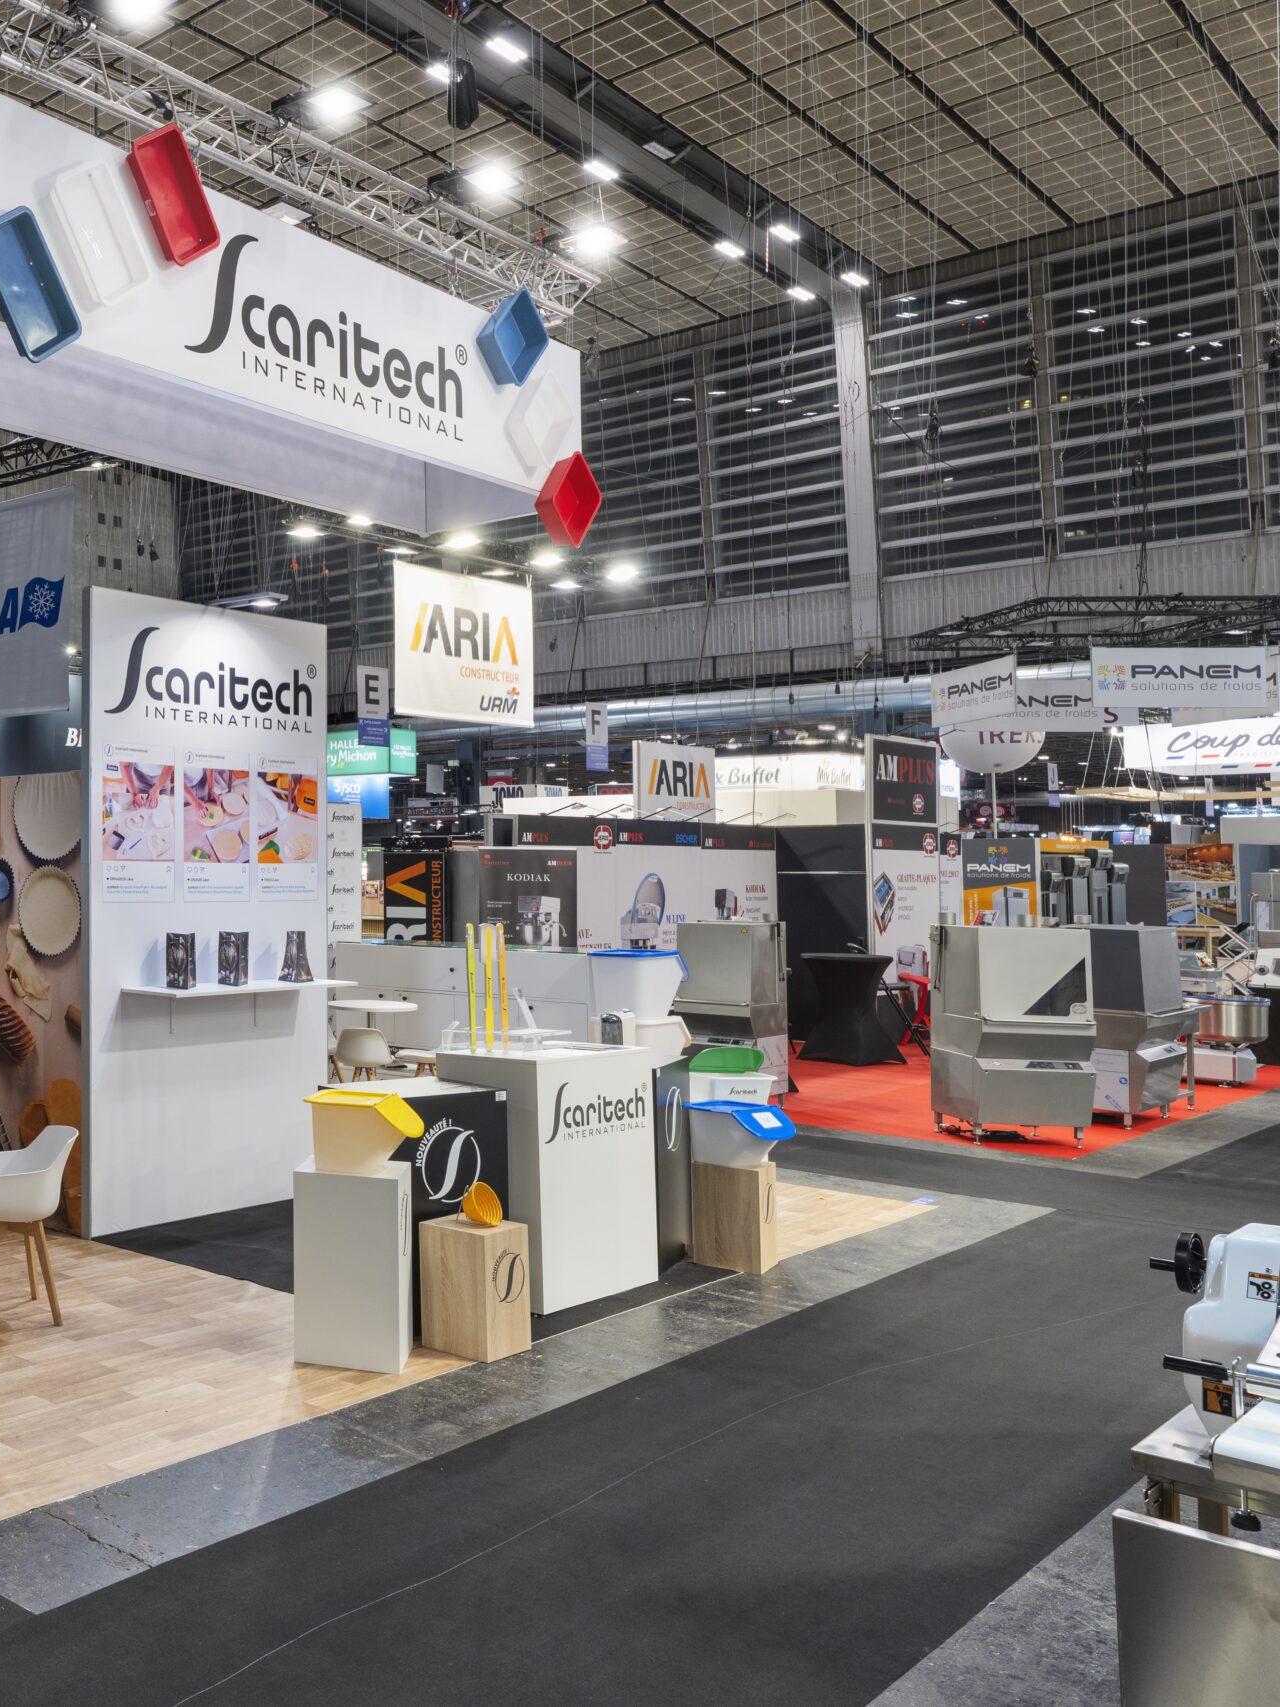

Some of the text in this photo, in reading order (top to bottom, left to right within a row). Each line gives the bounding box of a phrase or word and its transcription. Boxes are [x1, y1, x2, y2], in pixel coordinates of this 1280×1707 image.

[242, 351, 464, 442] INTERNATIONAL
[410, 602, 518, 666] ARIA
[459, 666, 520, 683] CONSTRUCTEUR
[1131, 664, 1261, 679] PANEM
[365, 674, 380, 705] E
[947, 672, 1013, 699] PANEM
[1131, 681, 1262, 691] solutions de froids
[480, 695, 518, 714] URM
[947, 689, 1014, 711] solutions de froids
[145, 705, 313, 734] INTERNATIONAL
[591, 709, 602, 735] F
[1045, 709, 1060, 718] de
[1065, 709, 1098, 718] froids
[330, 739, 365, 750] HALLE
[1167, 731, 1250, 757] Coup
[338, 749, 377, 761] Michon
[727, 768, 780, 785] Buffet
[831, 767, 852, 786] Buffet
[876, 753, 935, 785] AMPLUS
[648, 759, 710, 799] ARIA
[522, 832, 549, 842] AMPLUS
[619, 832, 643, 842] AMPLUS
[676, 834, 698, 844] ESCHER
[967, 863, 1031, 872] PANEM
[507, 873, 551, 882] KODIAK
[745, 884, 766, 893] KODIAK
[563, 1122, 646, 1142] INTERNATIONAL
[415, 1117, 448, 1167] NOUVEAUTÉ
